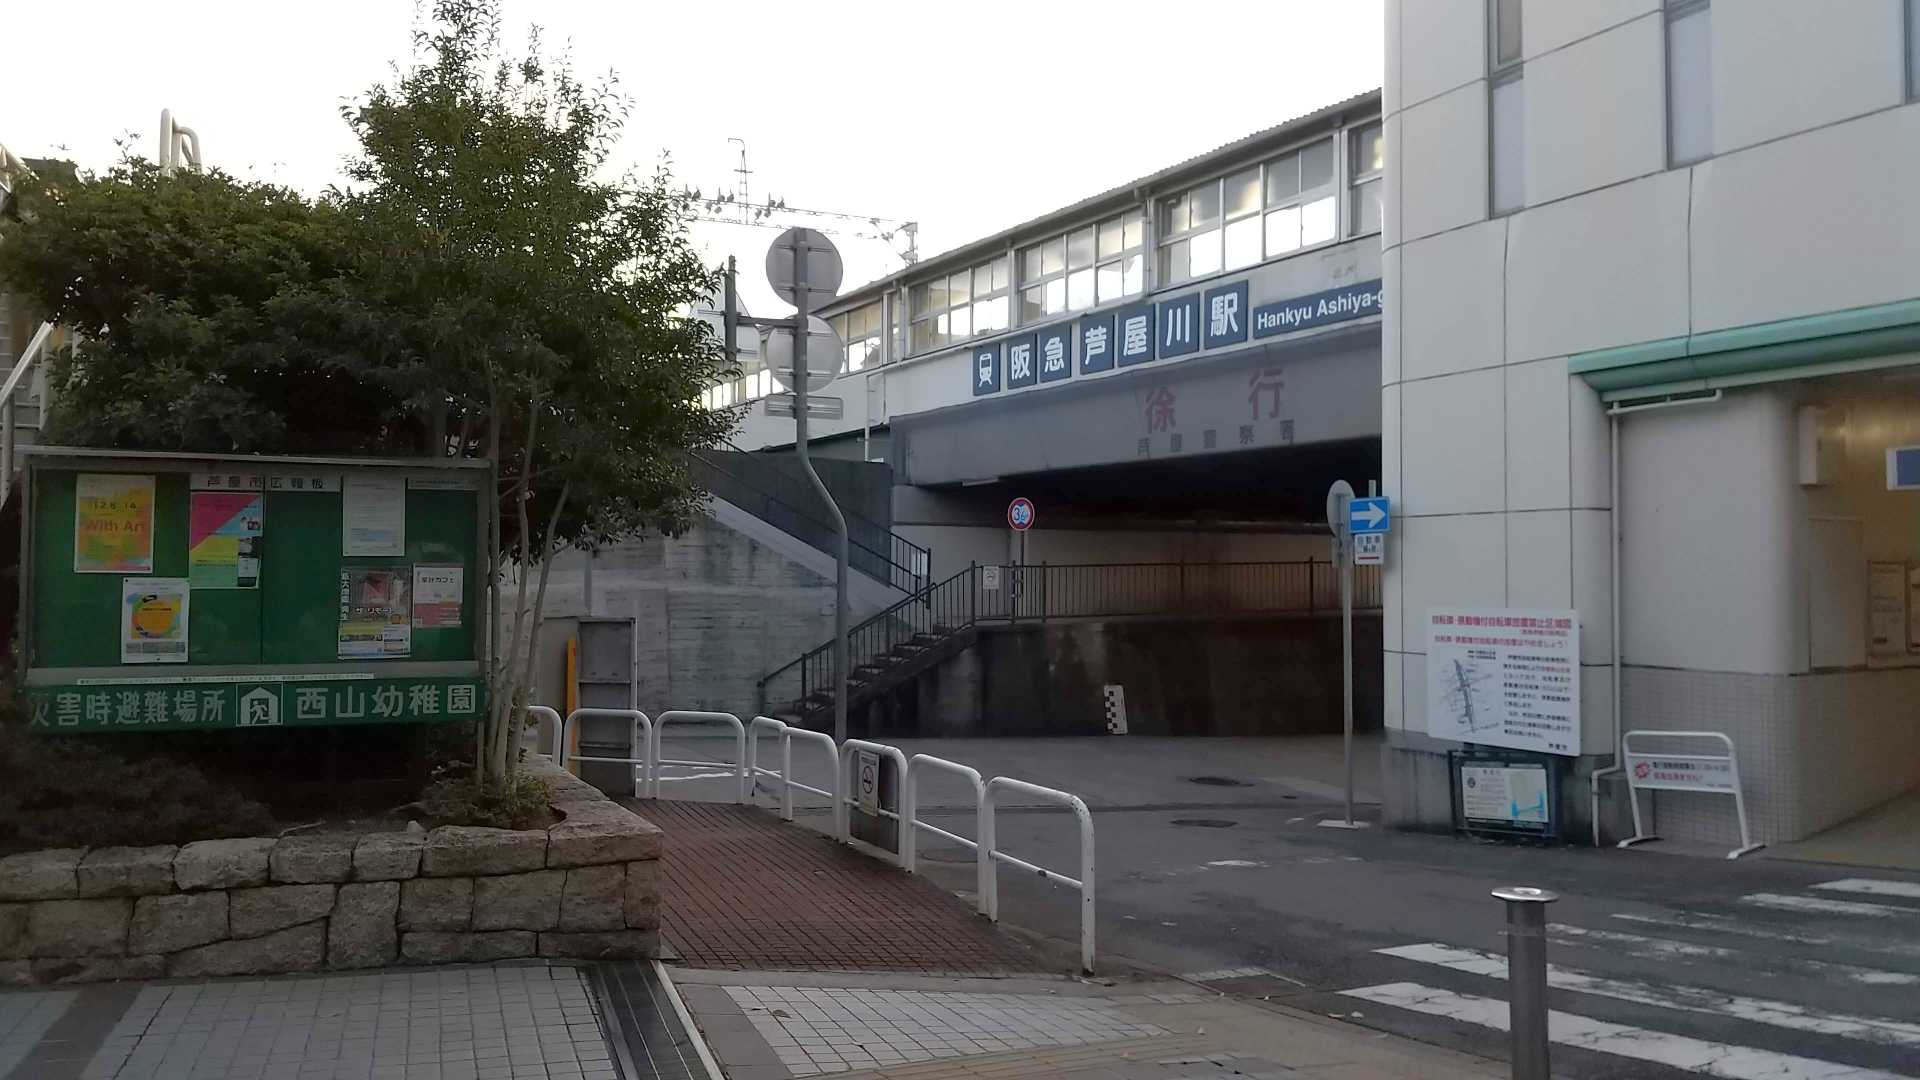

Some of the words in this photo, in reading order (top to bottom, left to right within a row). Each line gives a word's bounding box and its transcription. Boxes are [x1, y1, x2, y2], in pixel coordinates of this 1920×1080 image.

[1010, 292, 1239, 381] 阪急芦屋川駅
[1257, 303, 1312, 331] Hankyu
[1144, 369, 1284, 434] 徐行
[295, 684, 477, 720] 西山幼稚園
